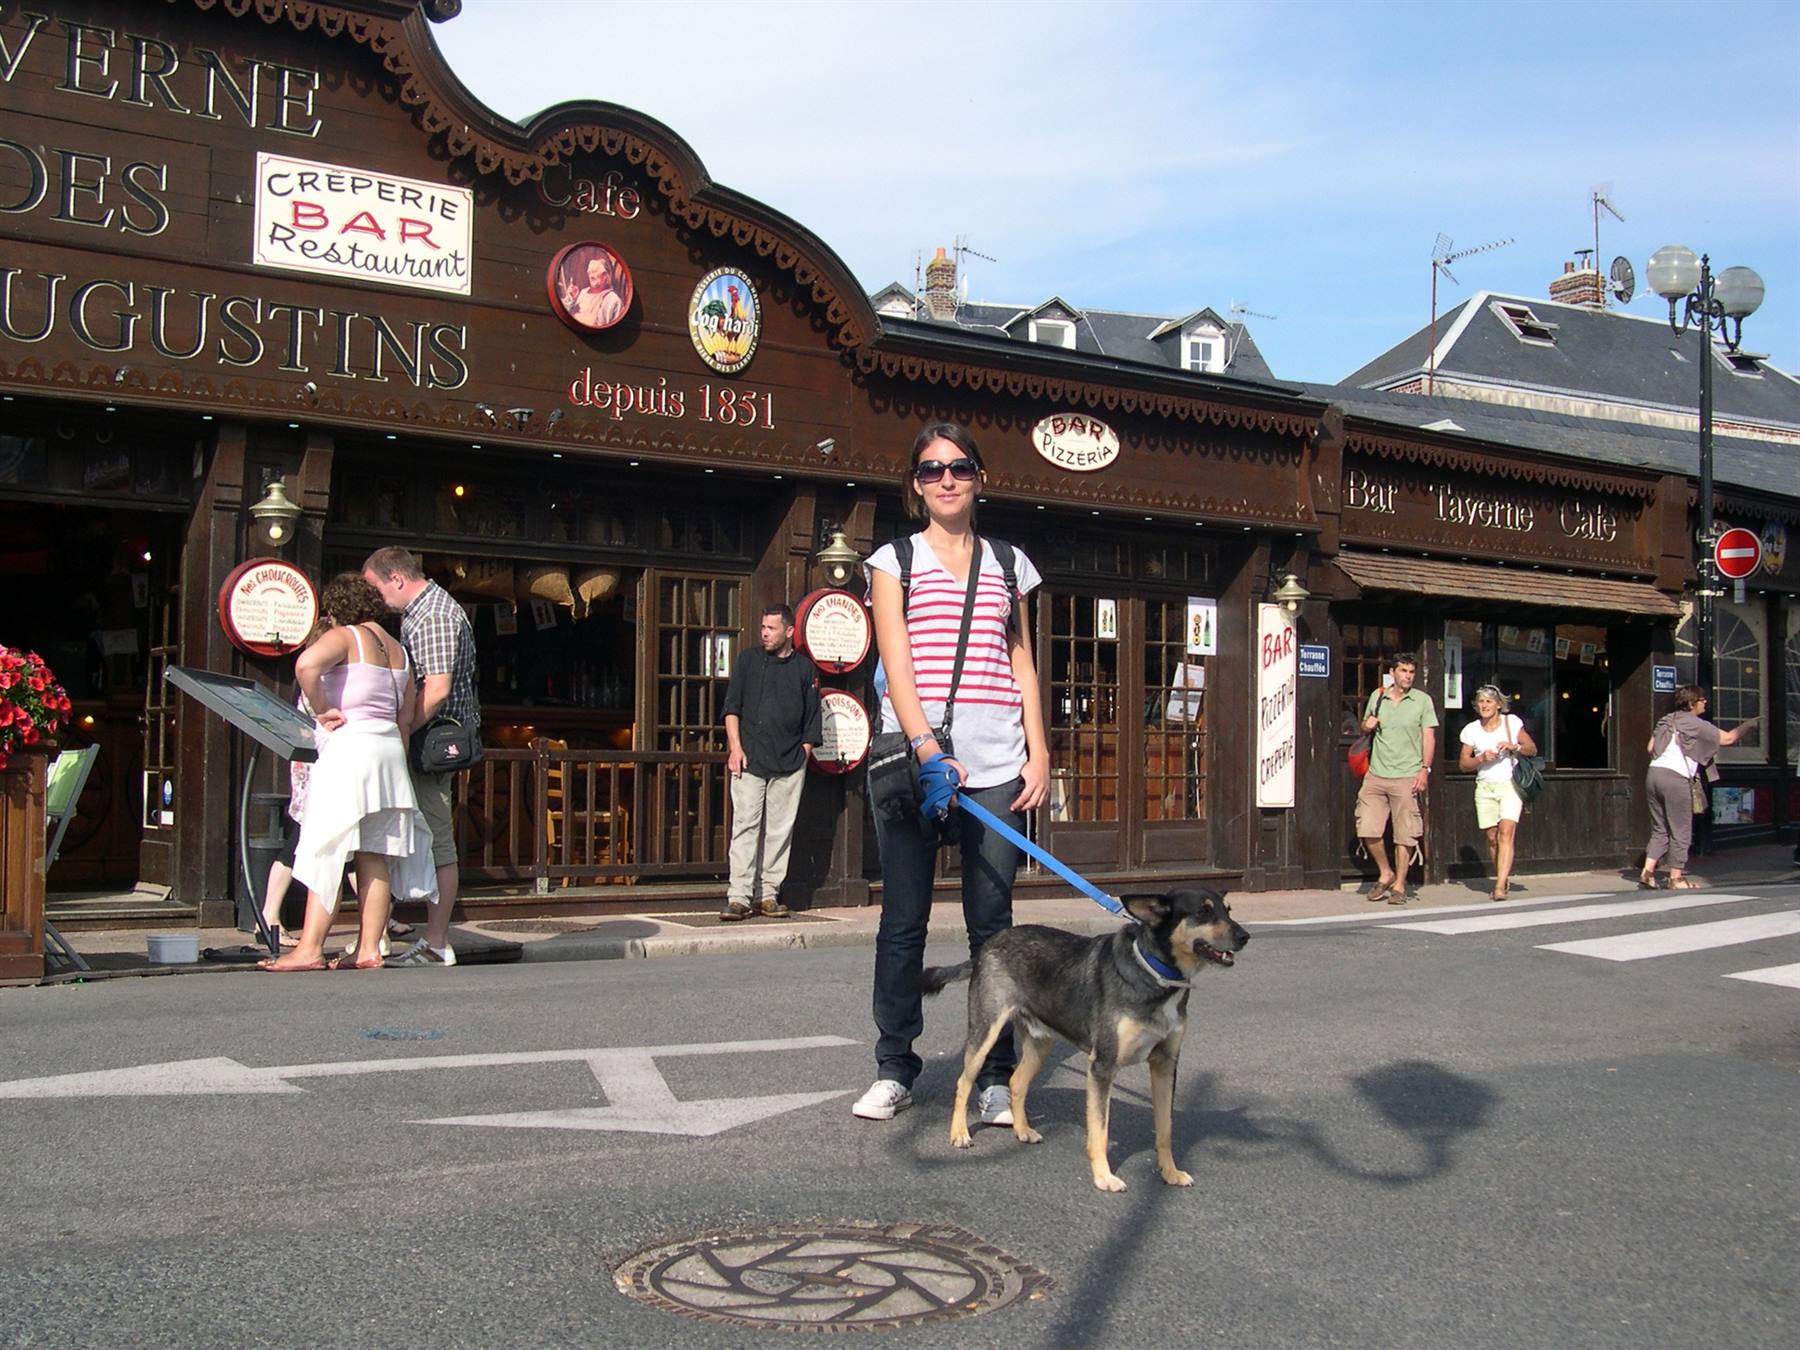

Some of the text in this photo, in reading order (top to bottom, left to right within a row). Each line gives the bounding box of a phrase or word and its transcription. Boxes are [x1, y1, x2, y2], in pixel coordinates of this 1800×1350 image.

[0, 139, 169, 236] DES
[269, 222, 466, 278] Restaurant
[291, 200, 441, 250] BAR
[0, 268, 469, 391] UGUSTINS
[568, 367, 775, 430] depuis 1851
[1051, 416, 1104, 442] BAR
[1344, 465, 1398, 514] Bar
[1423, 482, 1534, 533] Taverne
[256, 568, 310, 604] CHOUCROUTES
[825, 596, 862, 624] VIANDES
[1262, 627, 1294, 671] BAR
[825, 696, 863, 722] POISSONS
